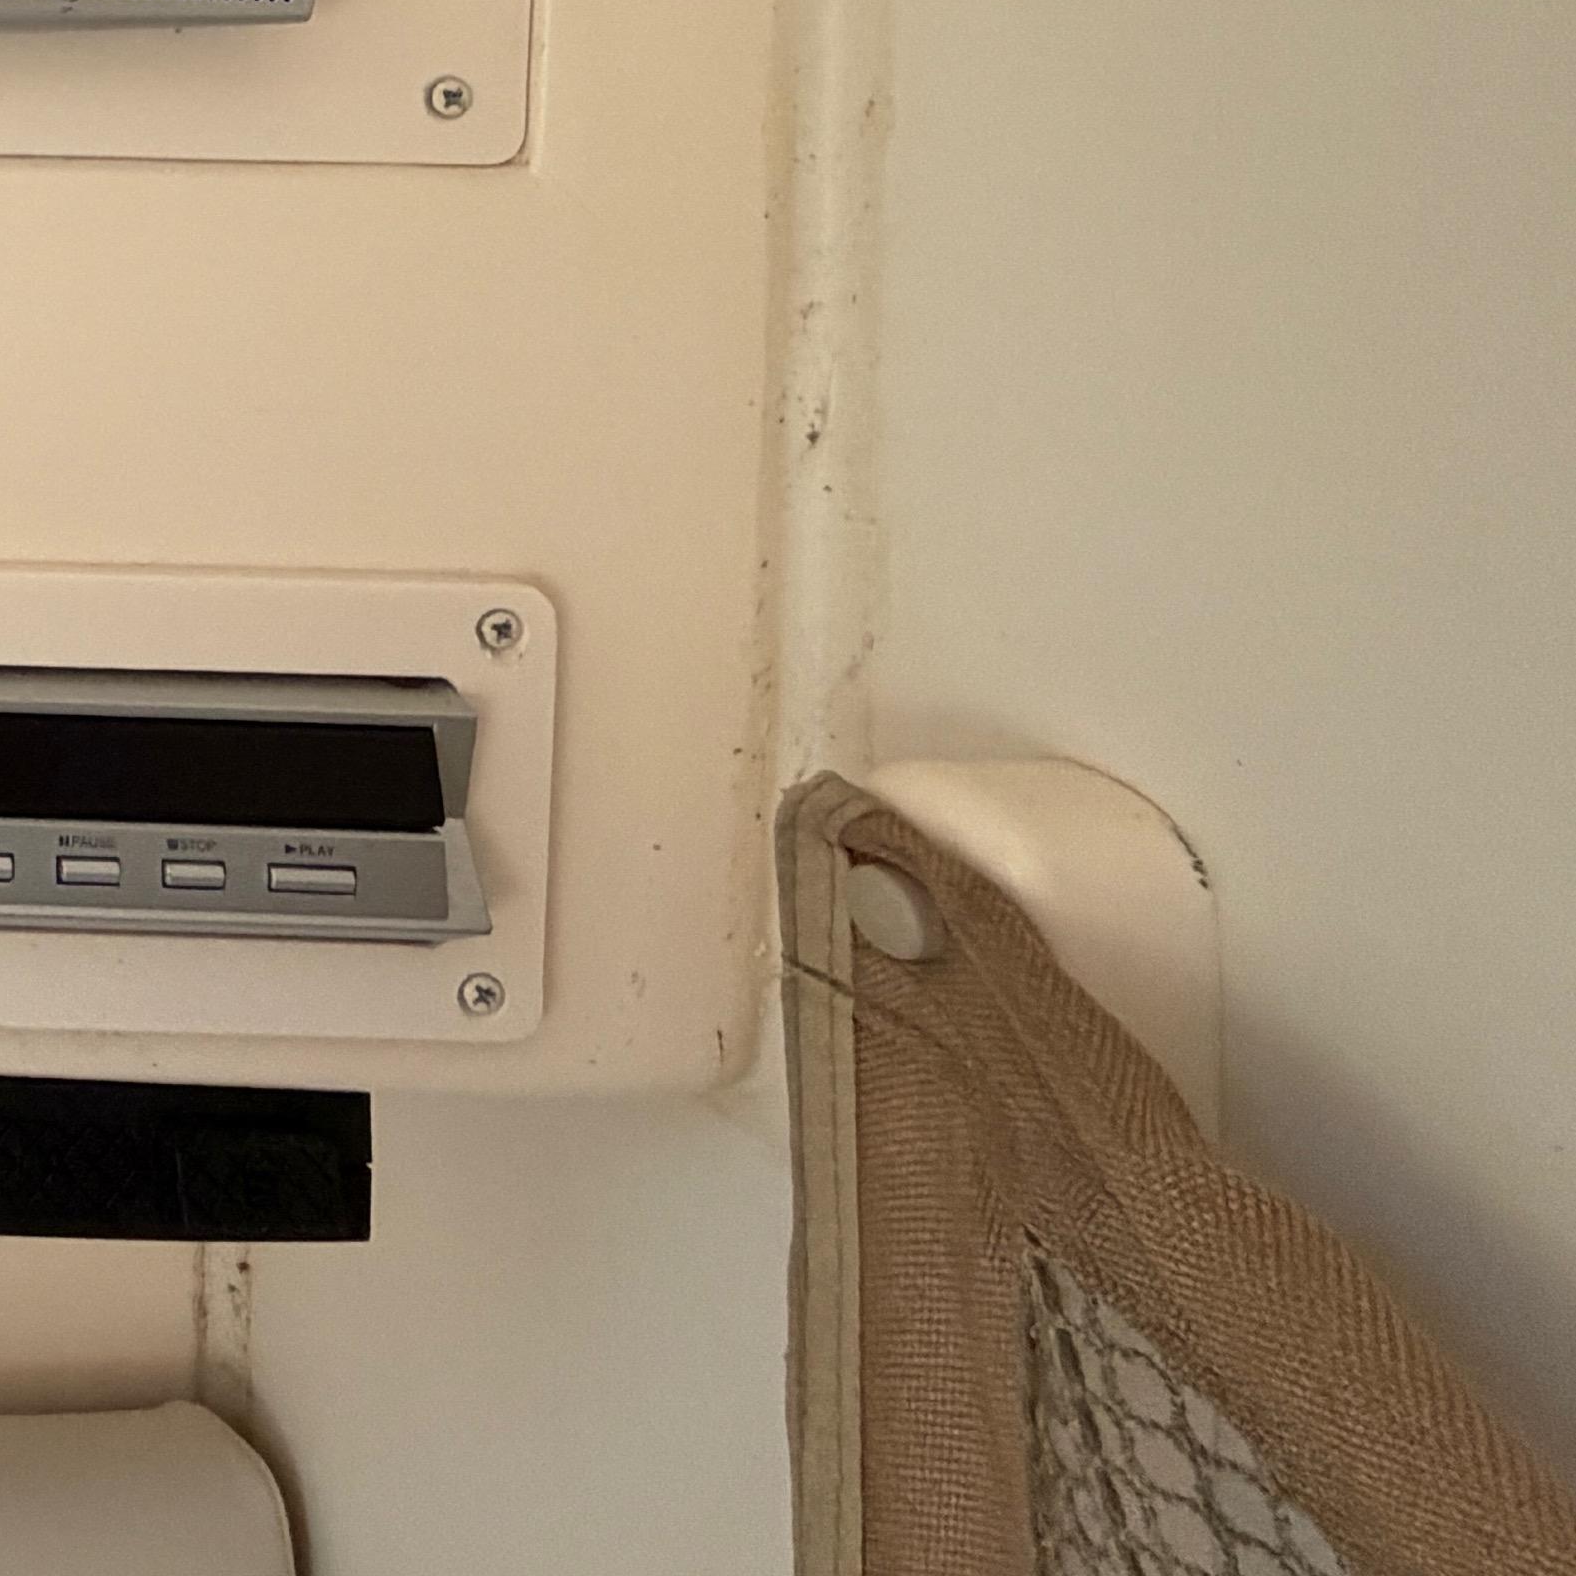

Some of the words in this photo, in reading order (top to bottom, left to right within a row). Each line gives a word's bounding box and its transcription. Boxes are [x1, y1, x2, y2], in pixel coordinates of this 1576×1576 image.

[70, 835, 117, 849] PAUSE
[179, 838, 217, 852] STOP
[299, 844, 335, 857] PLAY
